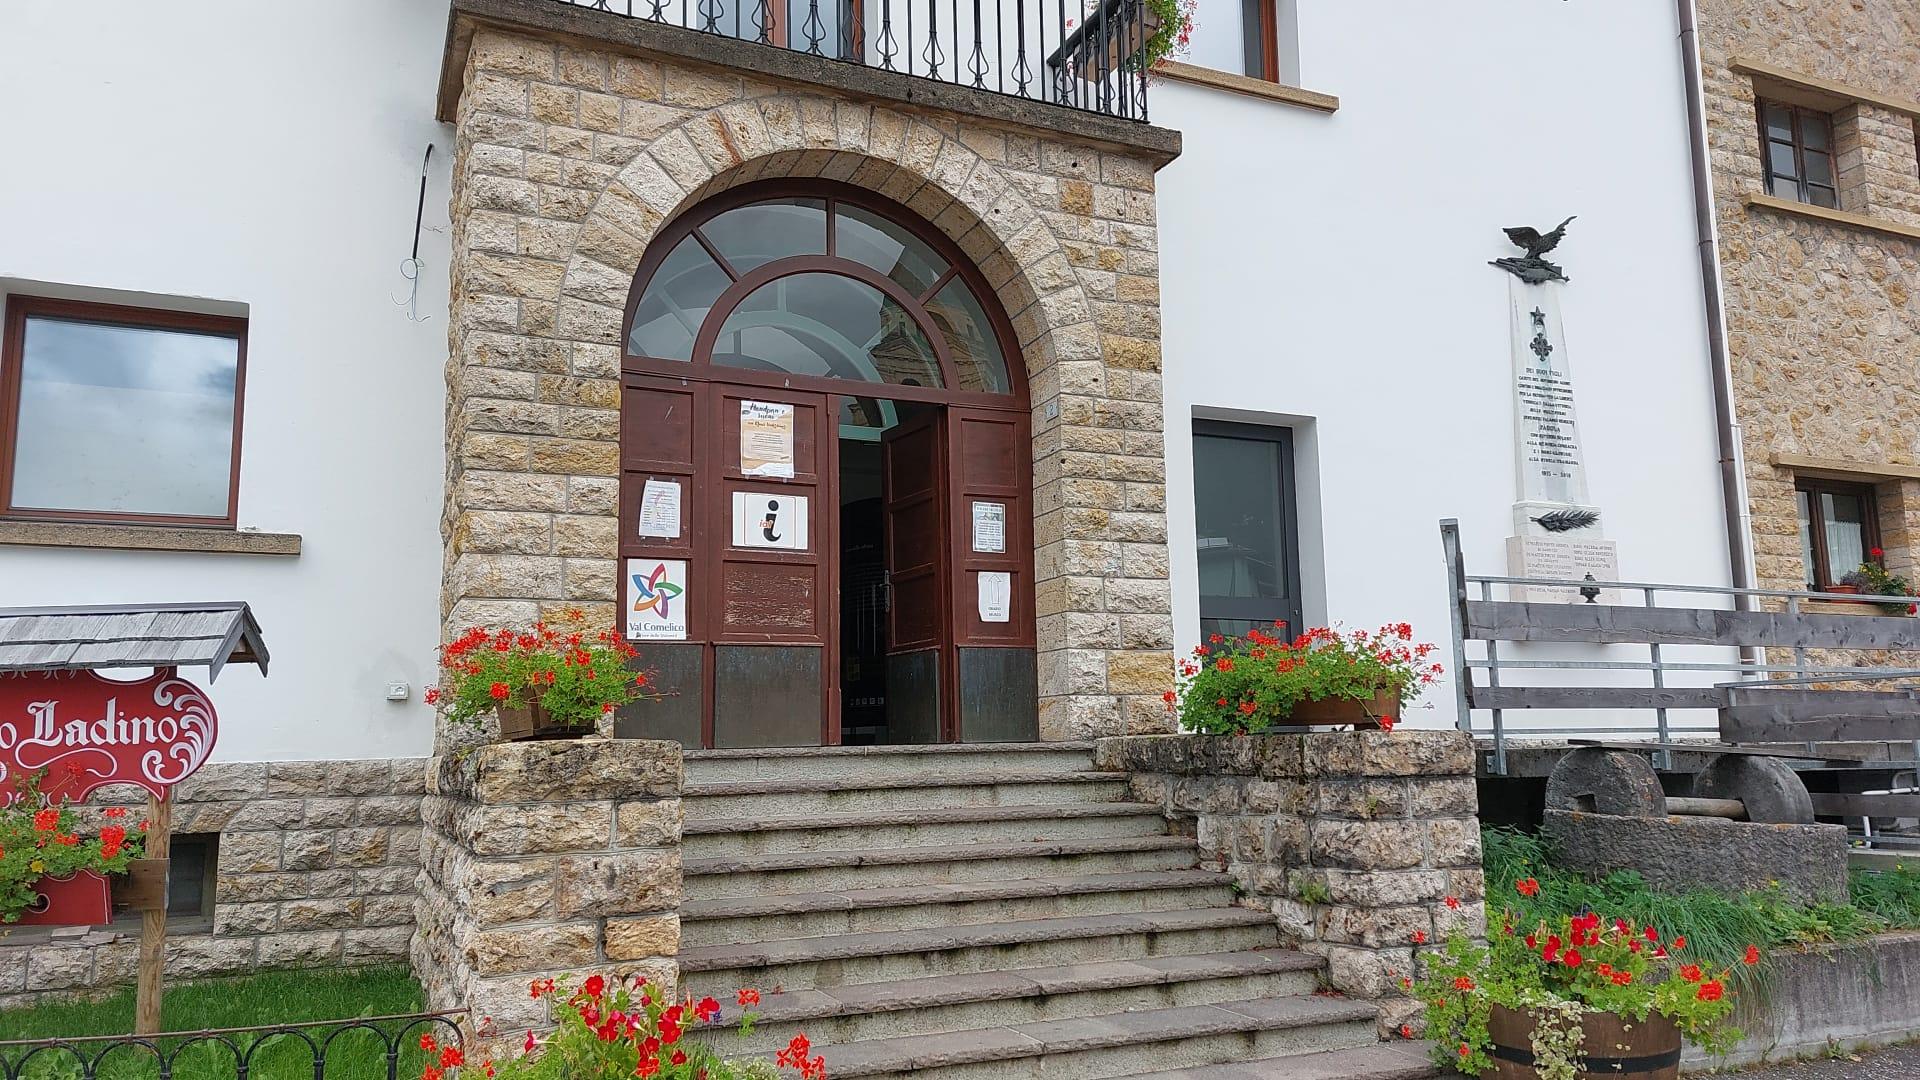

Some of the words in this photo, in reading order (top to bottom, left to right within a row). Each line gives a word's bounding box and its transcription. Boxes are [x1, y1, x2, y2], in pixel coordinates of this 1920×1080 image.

[629, 622, 642, 631] Val
[643, 622, 684, 632] Comelico
[26, 696, 178, 748] Ladino
